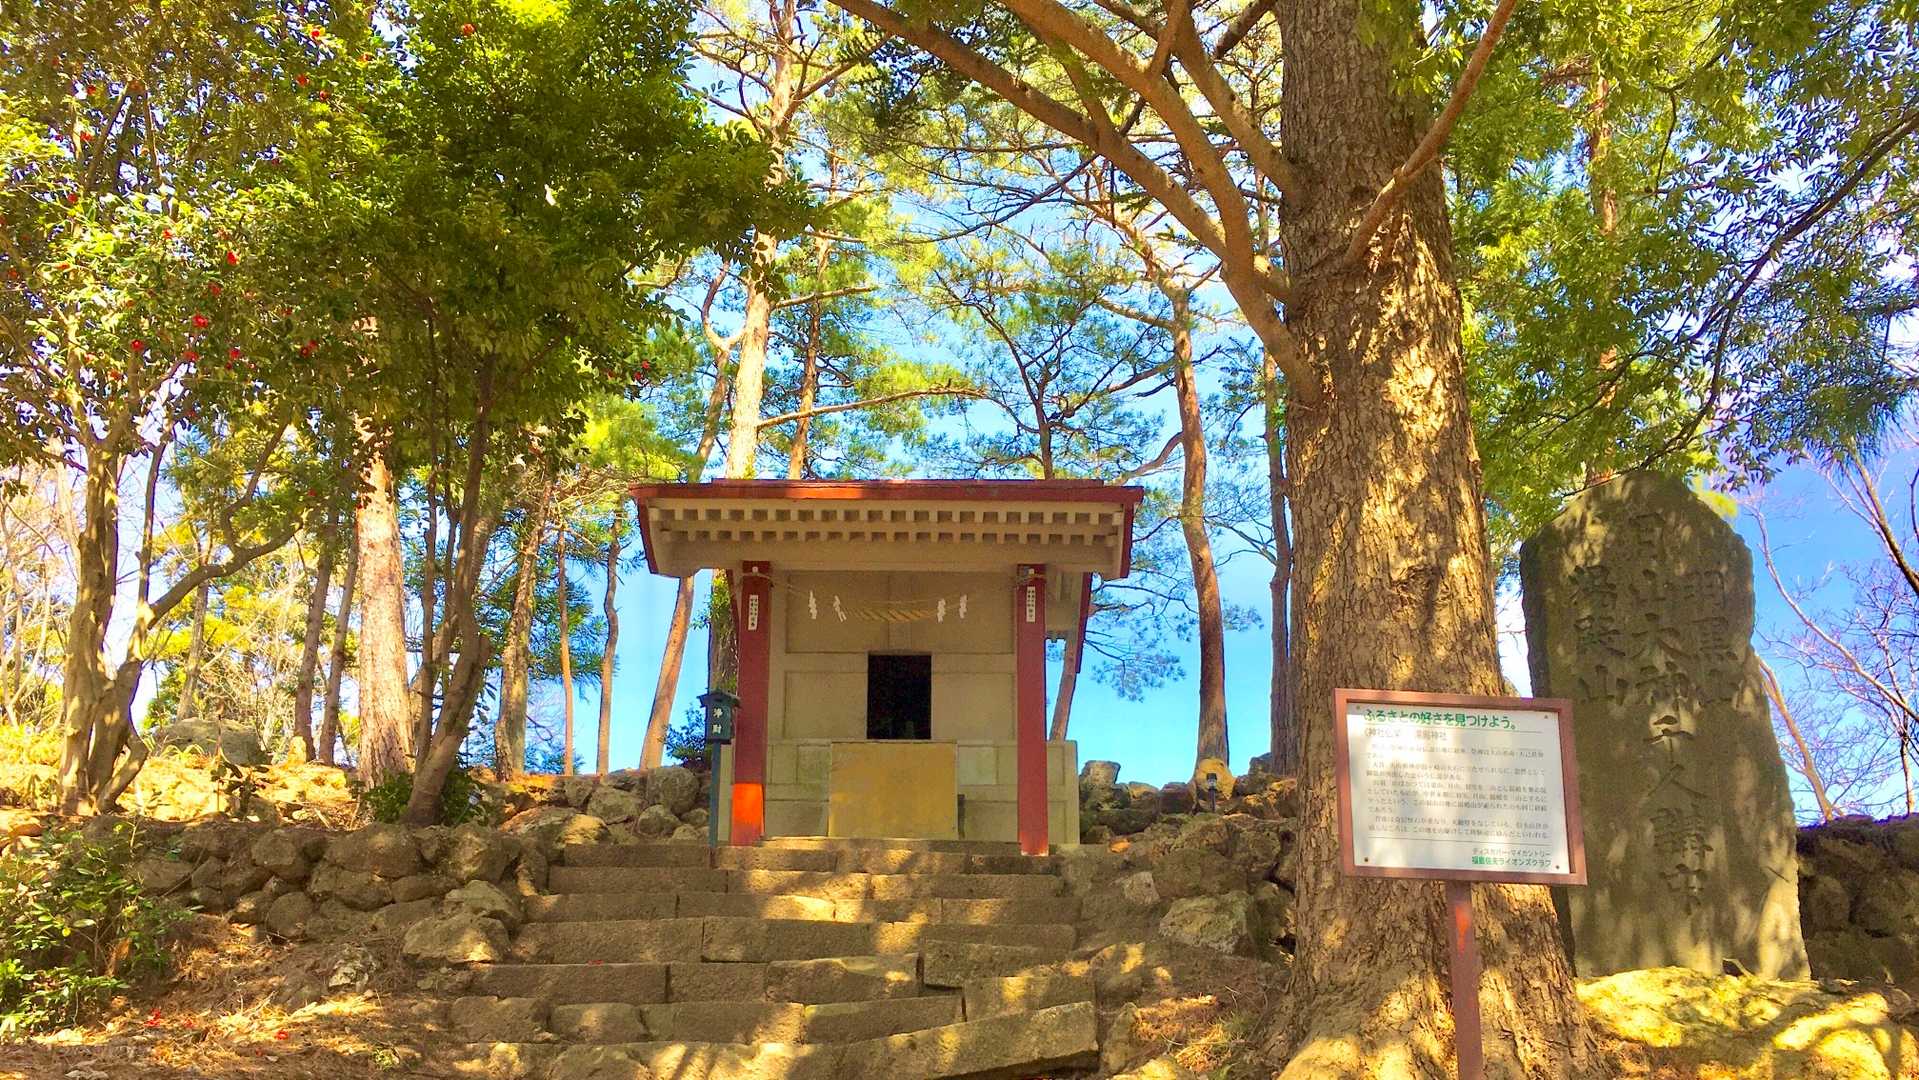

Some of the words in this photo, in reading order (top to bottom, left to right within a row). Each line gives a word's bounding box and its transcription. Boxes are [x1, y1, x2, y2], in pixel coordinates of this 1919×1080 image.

[1364, 709, 1516, 730] ふるさとの好さを見つけよう。
